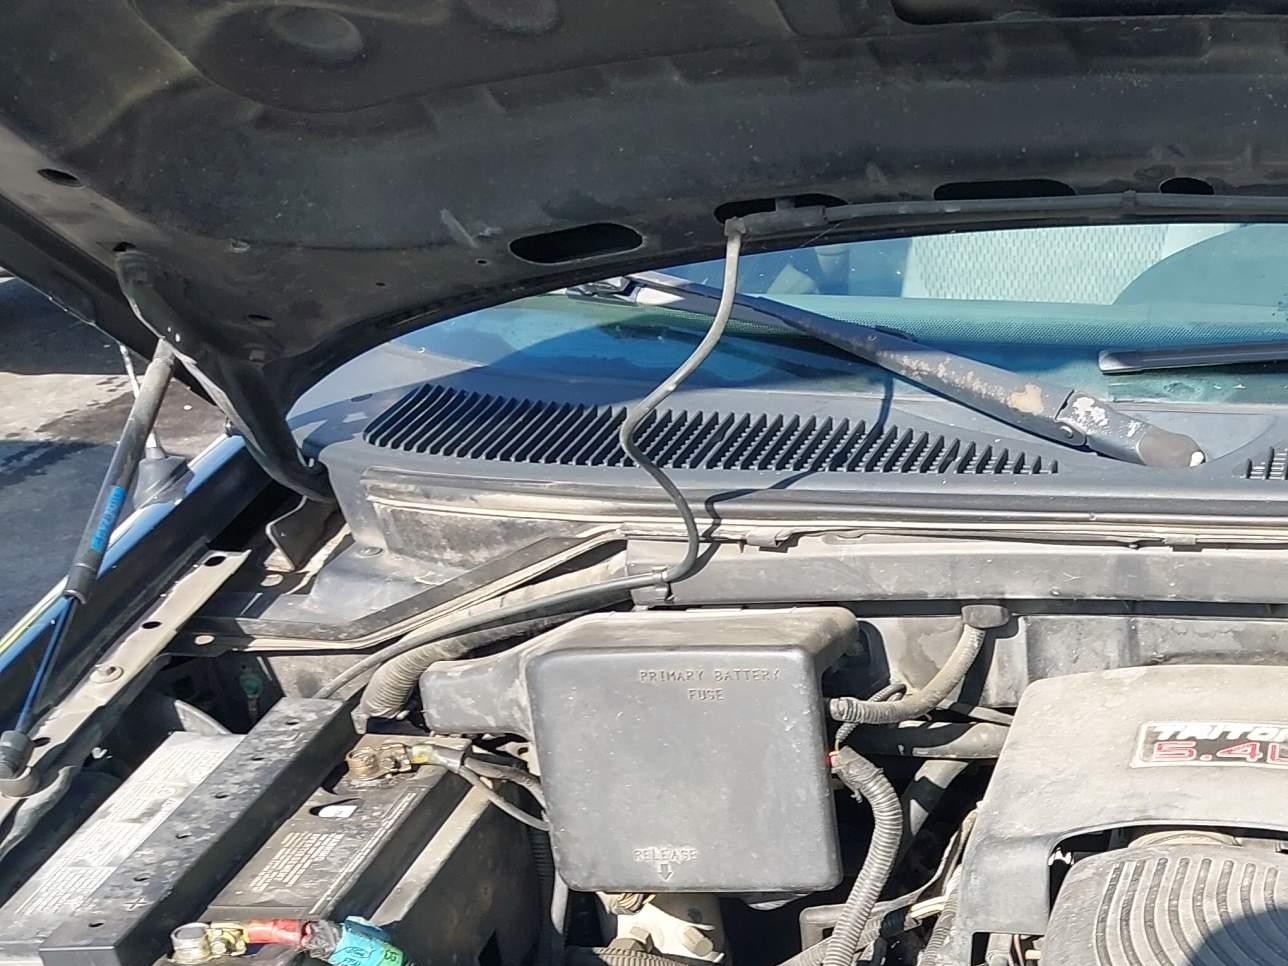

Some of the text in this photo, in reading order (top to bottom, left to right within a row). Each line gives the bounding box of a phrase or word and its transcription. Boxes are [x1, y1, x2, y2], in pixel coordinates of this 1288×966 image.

[640, 668, 782, 682] PRIMARY BATTERY
[688, 688, 725, 701] FUSE
[633, 848, 698, 862] RELEASE
